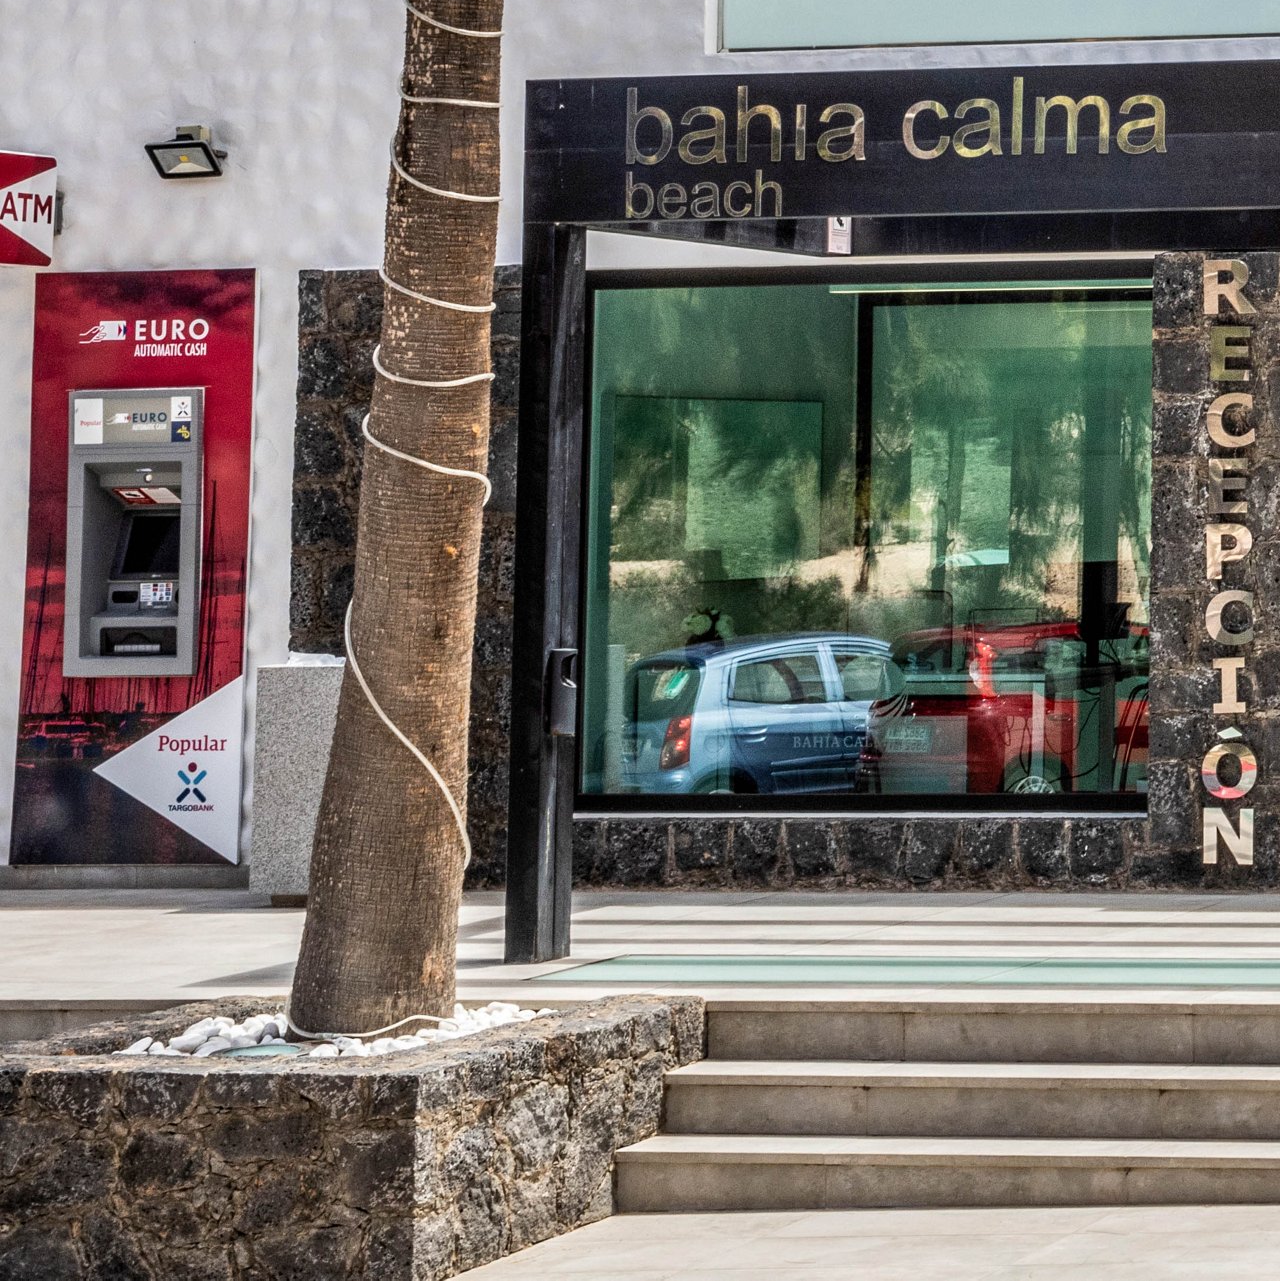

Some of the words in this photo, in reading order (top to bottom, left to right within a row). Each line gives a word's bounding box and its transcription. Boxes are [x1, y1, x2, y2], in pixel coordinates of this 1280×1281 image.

[904, 76, 1168, 160] calma
[625, 169, 783, 218] beach
[0, 191, 53, 224] ATM
[134, 319, 210, 341] EURO
[134, 344, 183, 357] AUTOMATIC
[184, 343, 207, 356] CASH
[132, 412, 168, 423] EURO
[1201, 259, 1258, 865] RECEPCIÓN
[158, 735, 228, 755] Popular
[168, 804, 215, 812] TARGOBANK
